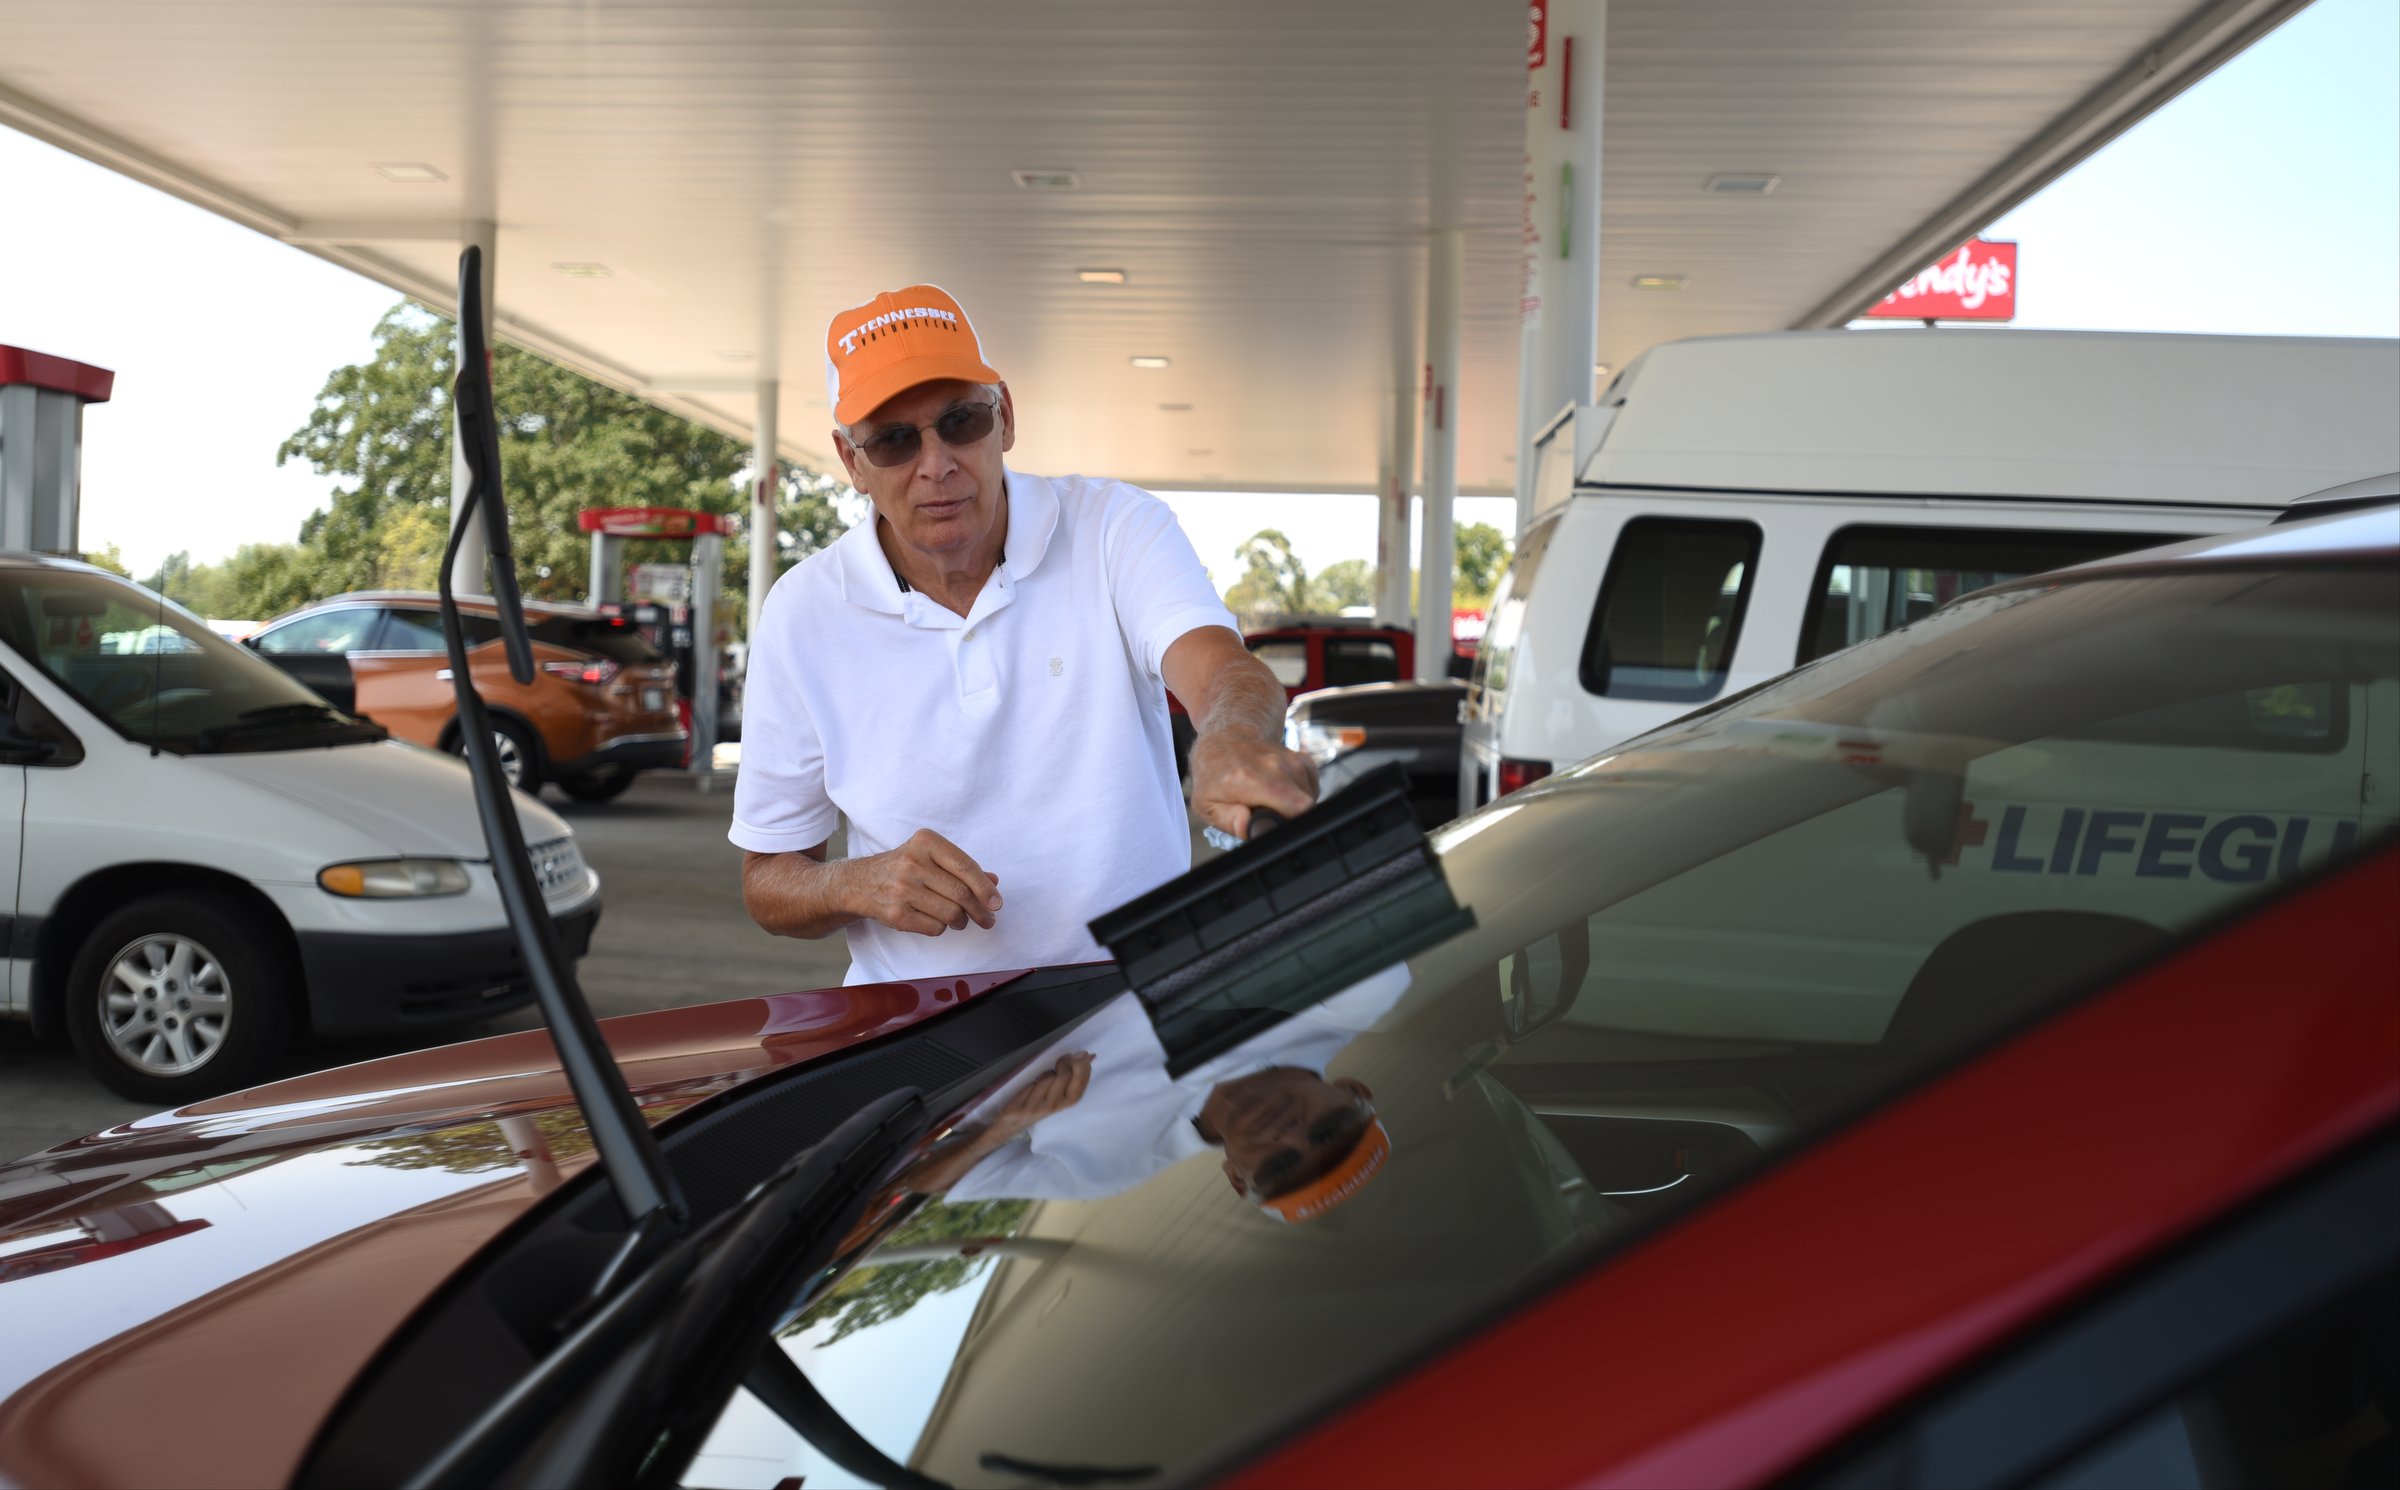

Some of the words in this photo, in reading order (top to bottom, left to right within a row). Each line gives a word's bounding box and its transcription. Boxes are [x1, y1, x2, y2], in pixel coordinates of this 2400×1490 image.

[1886, 246, 2010, 309] endy's
[857, 307, 957, 336] TENNESSEE
[861, 320, 957, 346] VOLUNTEERS
